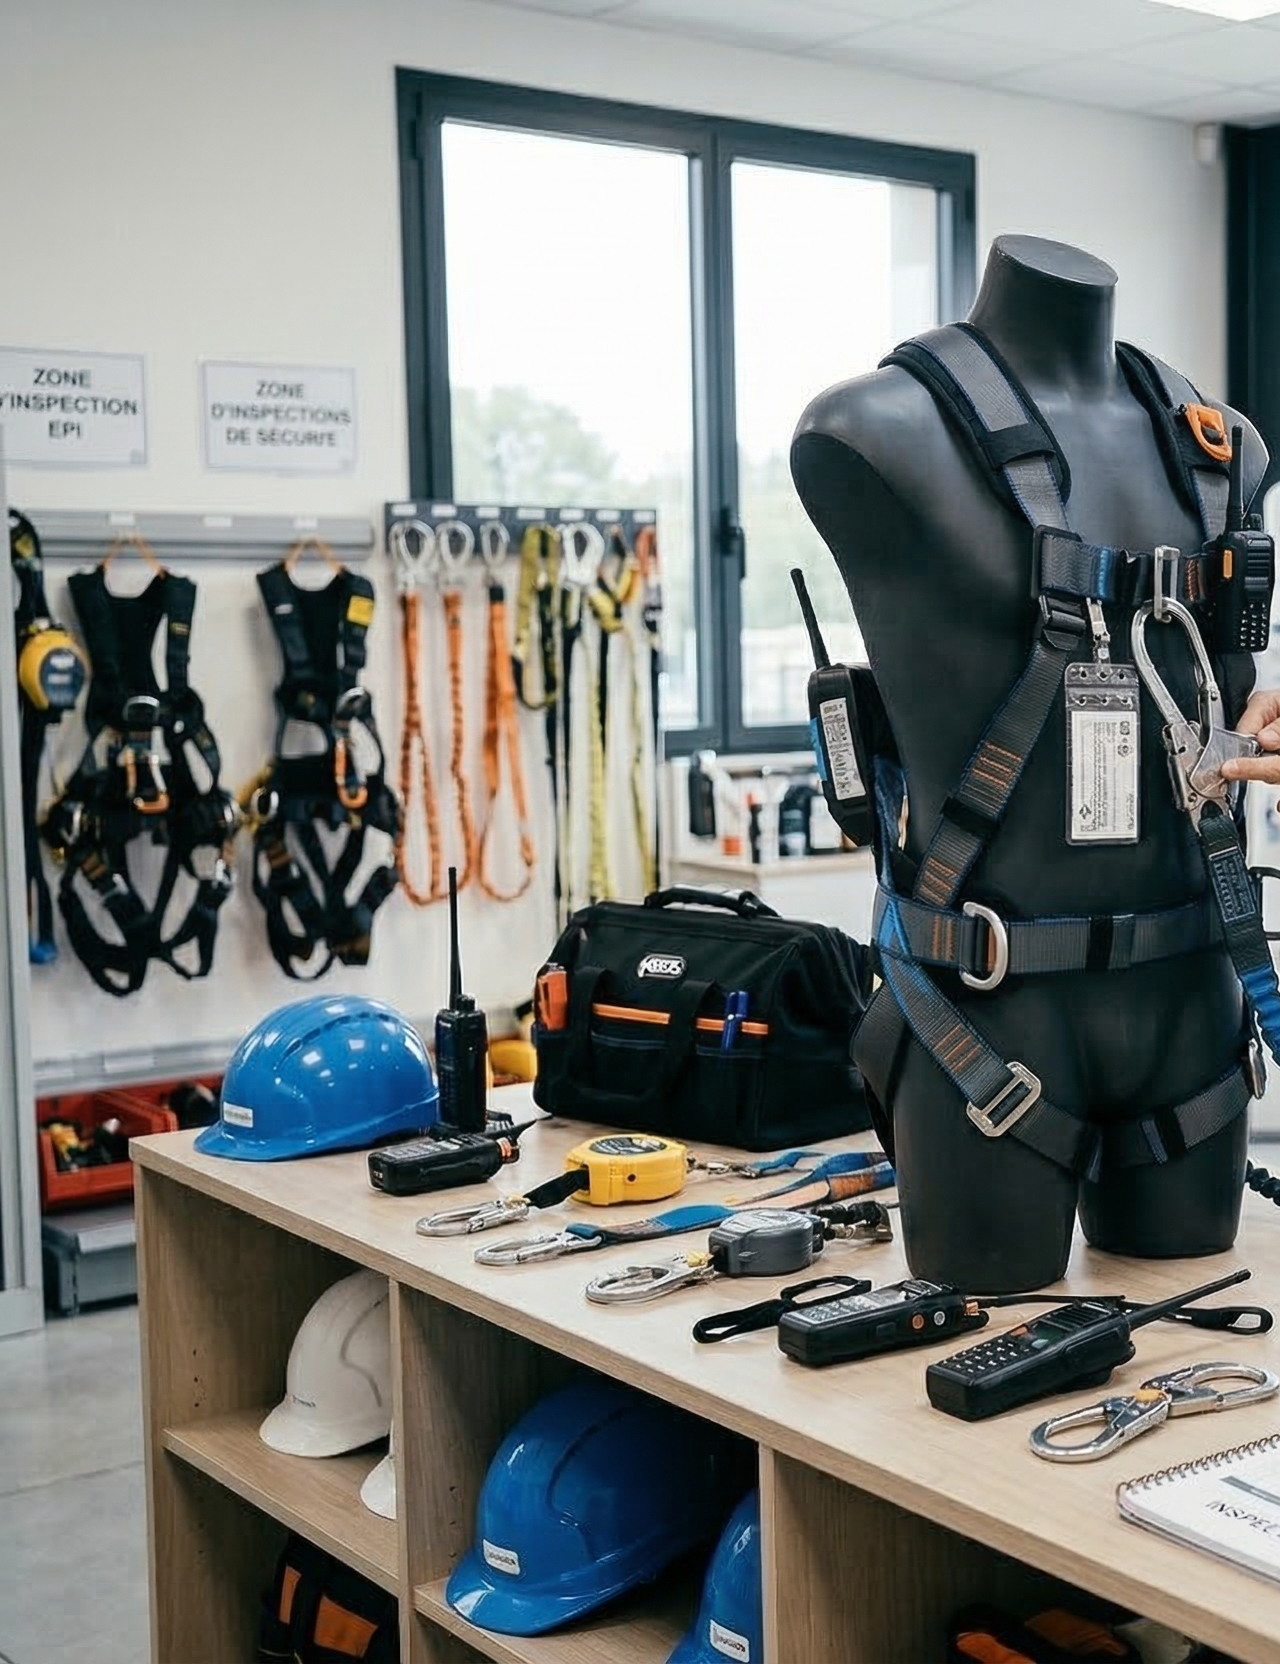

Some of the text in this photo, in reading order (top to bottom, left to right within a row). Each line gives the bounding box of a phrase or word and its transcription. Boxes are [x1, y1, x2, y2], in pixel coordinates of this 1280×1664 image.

[33, 370, 91, 388] ZONE
[256, 381, 304, 398] ZONE
[0, 392, 138, 415] 'INSPECTION
[211, 402, 351, 426] D'INSPECTIONS
[48, 419, 81, 438] EPI
[226, 427, 251, 446] DE
